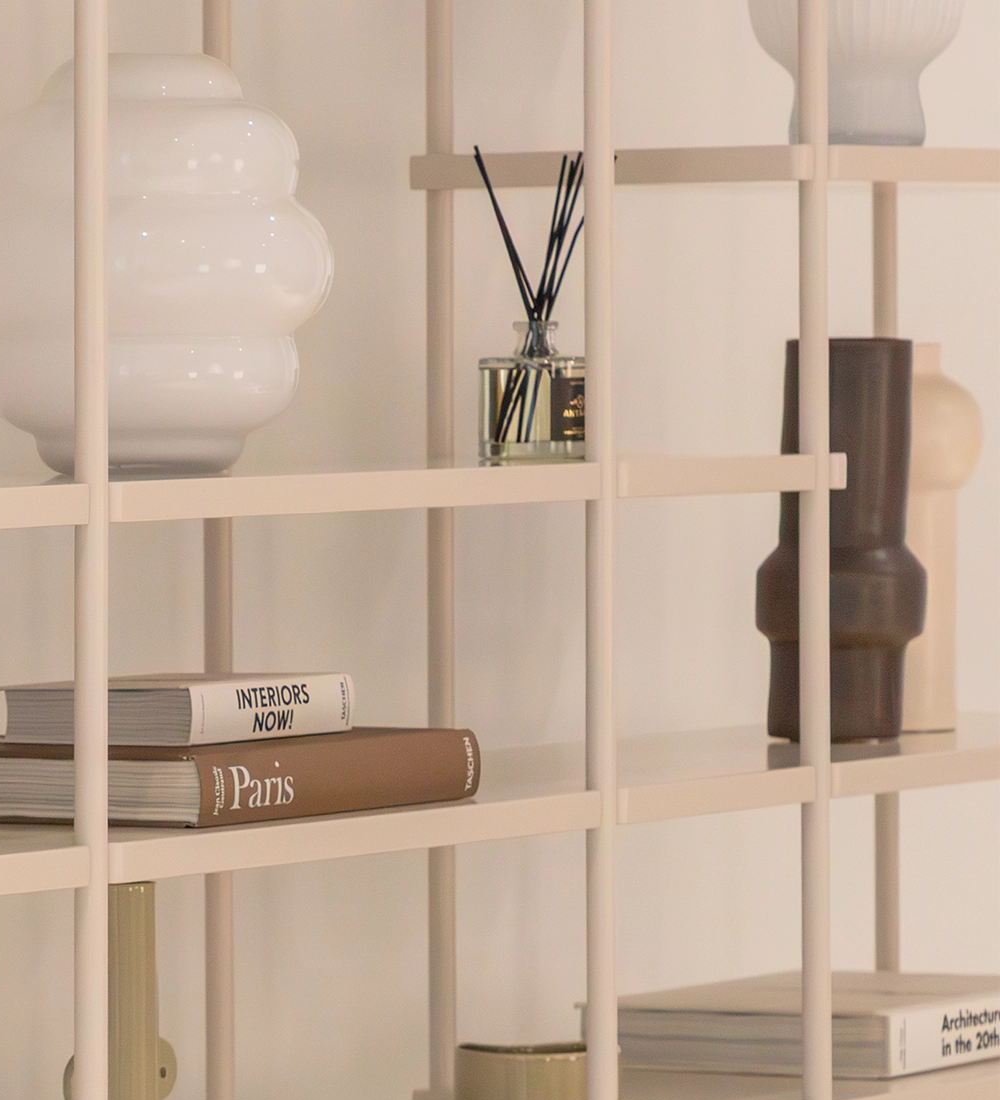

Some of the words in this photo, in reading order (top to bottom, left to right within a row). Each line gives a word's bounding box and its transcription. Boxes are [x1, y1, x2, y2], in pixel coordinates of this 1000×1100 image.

[236, 683, 310, 710] INTERIORS
[252, 709, 294, 733] NOW!
[463, 736, 475, 791] TASCHEN
[228, 760, 295, 810] Paris
[941, 1008, 1000, 1033] Architectur
[941, 1037, 952, 1057] in
[955, 1033, 972, 1054] the
[976, 1026, 1000, 1050] 20th
